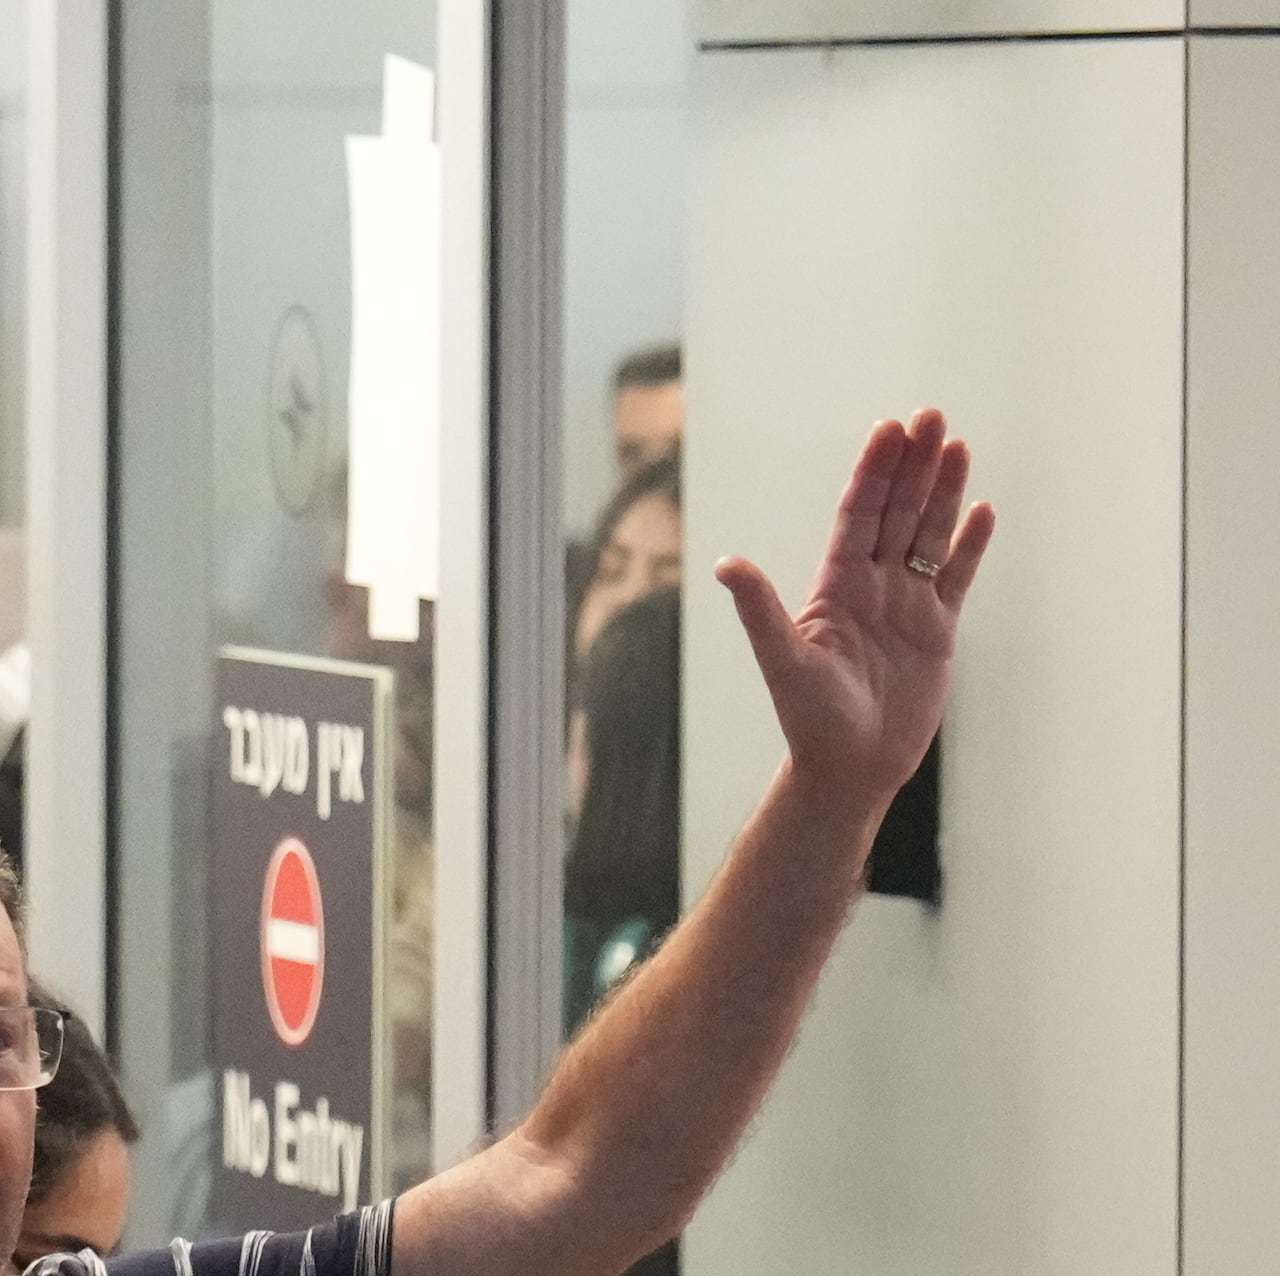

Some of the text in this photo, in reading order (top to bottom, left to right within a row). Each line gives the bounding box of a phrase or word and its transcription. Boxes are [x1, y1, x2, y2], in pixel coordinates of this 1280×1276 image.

[222, 705, 366, 821] אין מעבר
[222, 1068, 364, 1214] No Entry
